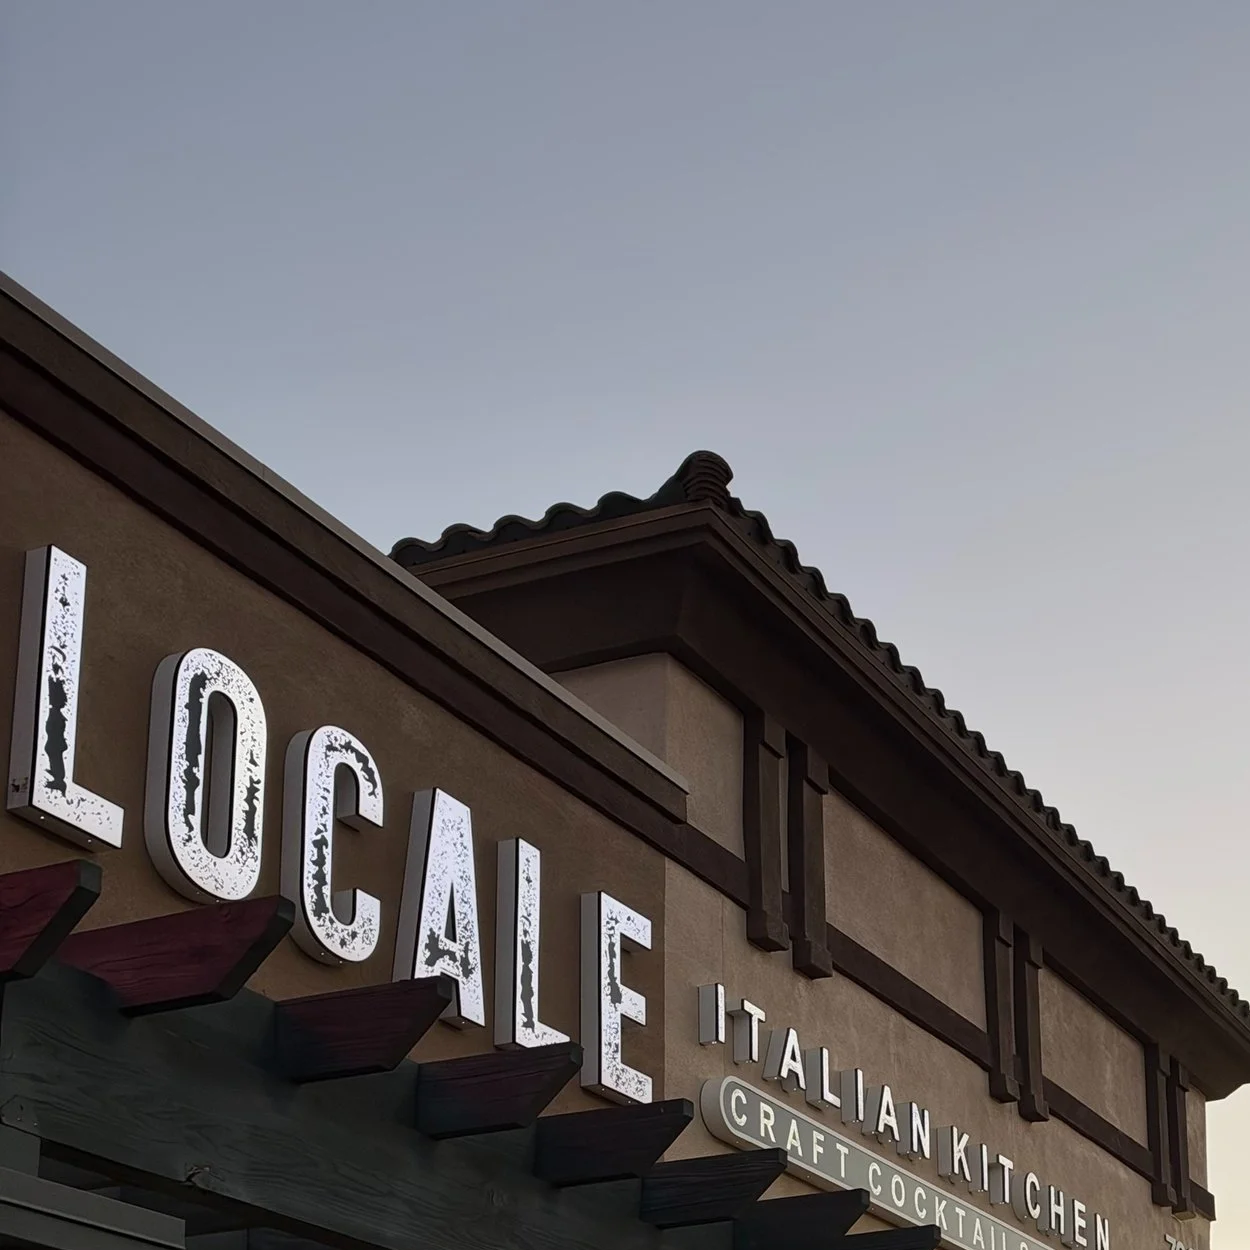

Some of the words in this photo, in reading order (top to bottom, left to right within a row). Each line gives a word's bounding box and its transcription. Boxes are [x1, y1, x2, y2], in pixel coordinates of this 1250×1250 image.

[24, 544, 654, 1105] LOCALE
[714, 983, 931, 1159] ITALIAN
[731, 1088, 850, 1179] CRAFT
